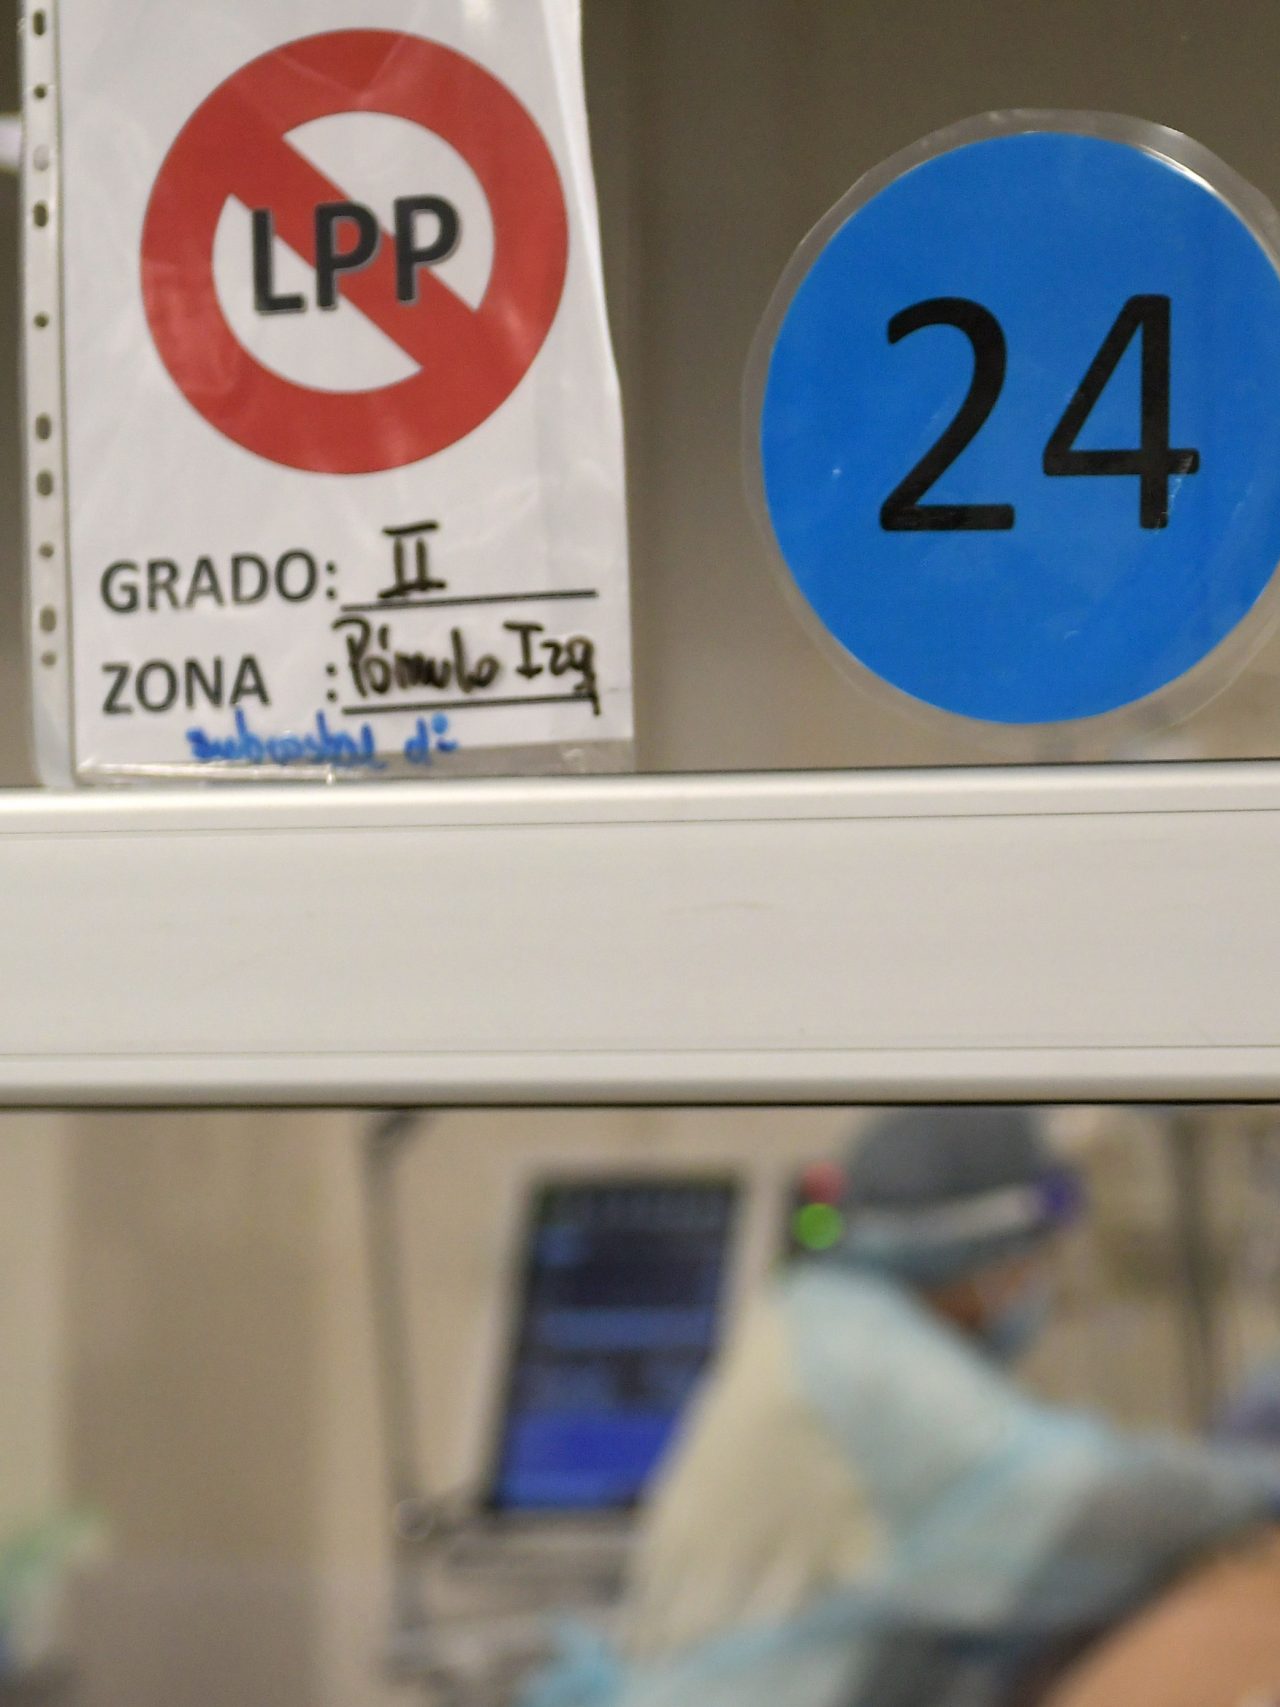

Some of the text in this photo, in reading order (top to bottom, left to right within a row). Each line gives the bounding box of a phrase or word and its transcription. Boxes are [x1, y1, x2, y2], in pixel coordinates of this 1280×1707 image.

[252, 194, 463, 317] LPP
[880, 293, 1200, 531] 24
[100, 548, 337, 614] GRADO:
[102, 654, 271, 715] ZONA
